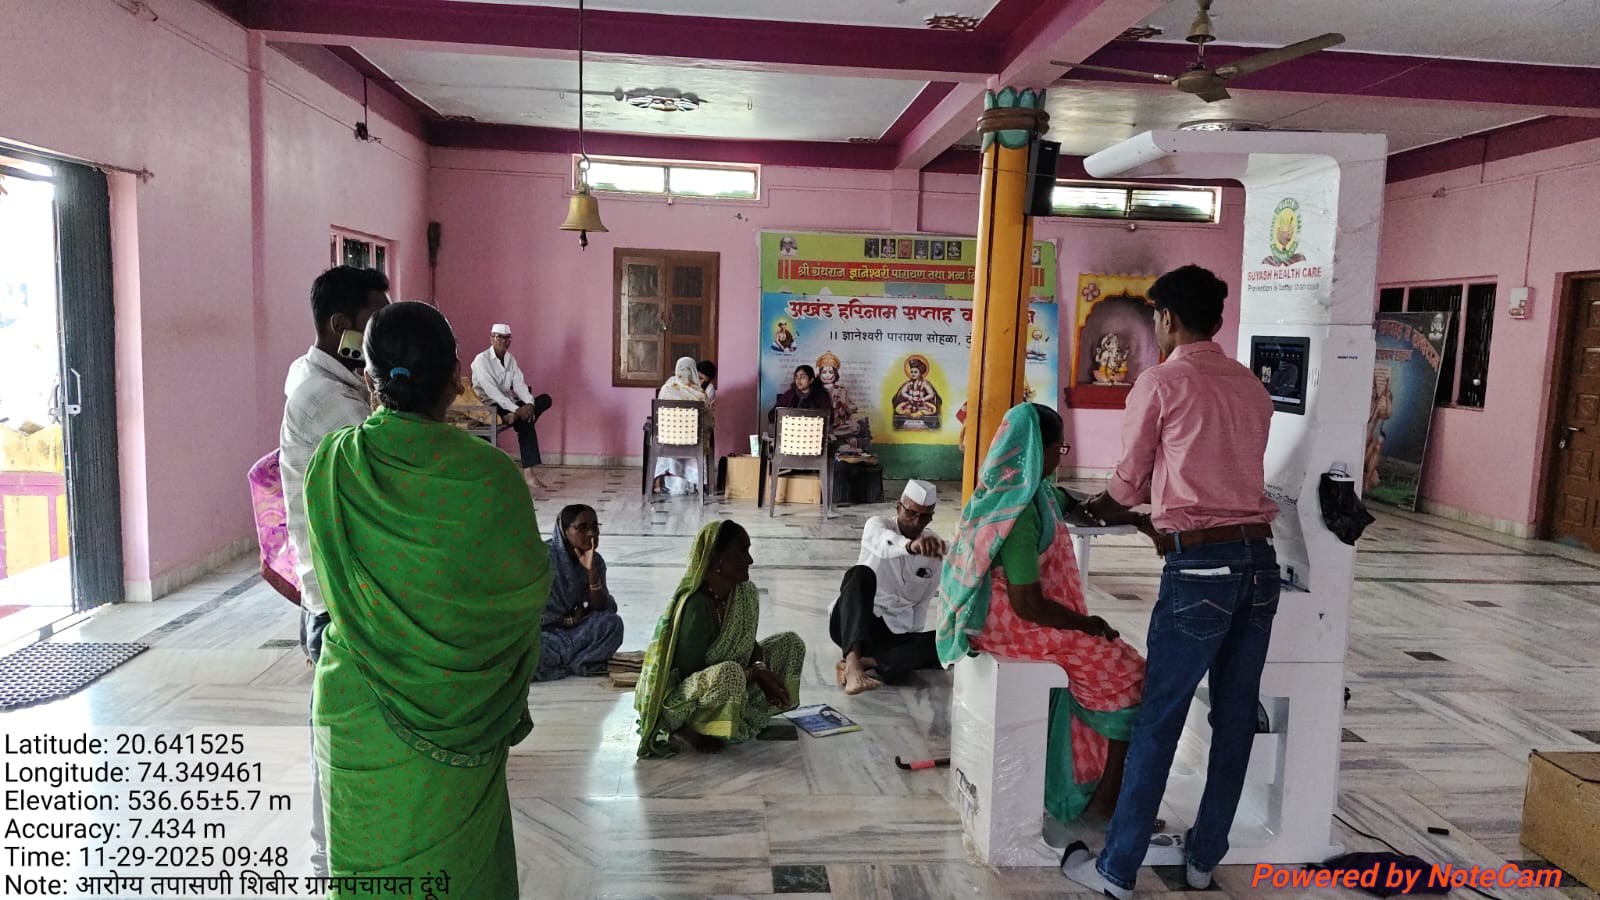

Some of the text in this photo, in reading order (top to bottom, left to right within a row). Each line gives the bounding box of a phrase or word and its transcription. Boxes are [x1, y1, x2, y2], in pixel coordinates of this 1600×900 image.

[798, 262, 810, 277] श्री
[849, 264, 889, 280] ज्ञानेश्वरी
[891, 269, 926, 280] पारायण
[928, 270, 945, 280] तथा
[948, 271, 965, 280] भव्य
[1247, 266, 1322, 281] SUYASH HEALTH CARE
[789, 298, 835, 319] अखंड
[837, 297, 898, 320] हरिनाम
[902, 305, 955, 323] सप्ताह
[842, 328, 883, 341] ज्ञानेश्वरी
[887, 332, 922, 343] पारायण
[926, 331, 961, 346] सोहळा,
